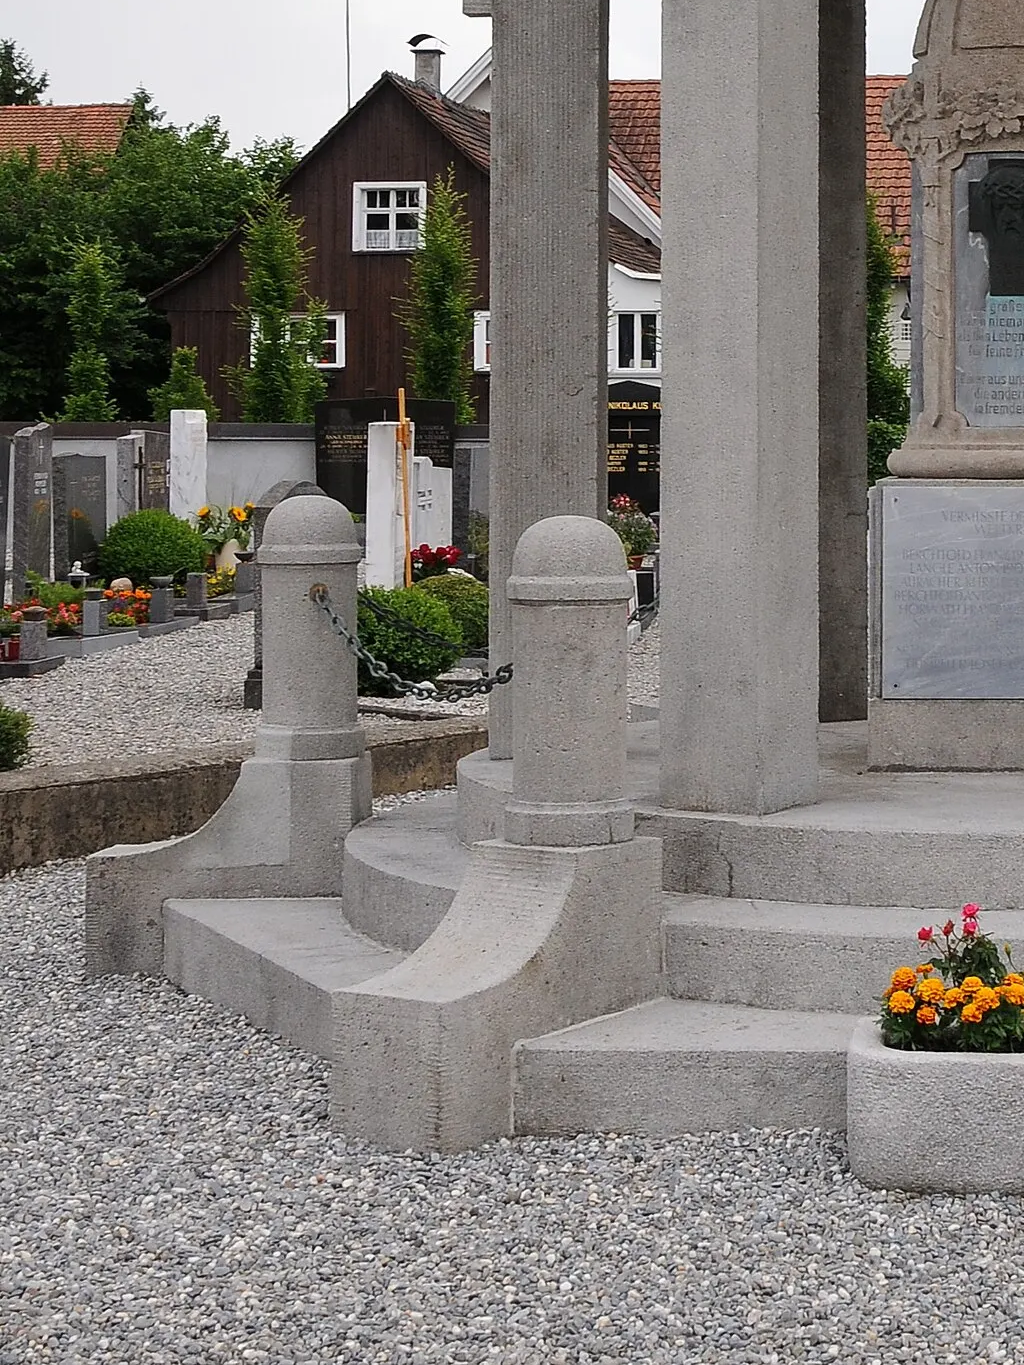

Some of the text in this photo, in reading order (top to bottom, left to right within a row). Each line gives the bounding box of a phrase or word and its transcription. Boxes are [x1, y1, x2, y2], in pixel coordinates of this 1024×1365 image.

[992, 330, 1024, 342] Leben
[987, 375, 1007, 385] aus
[941, 511, 1007, 522] VERMISSTE
